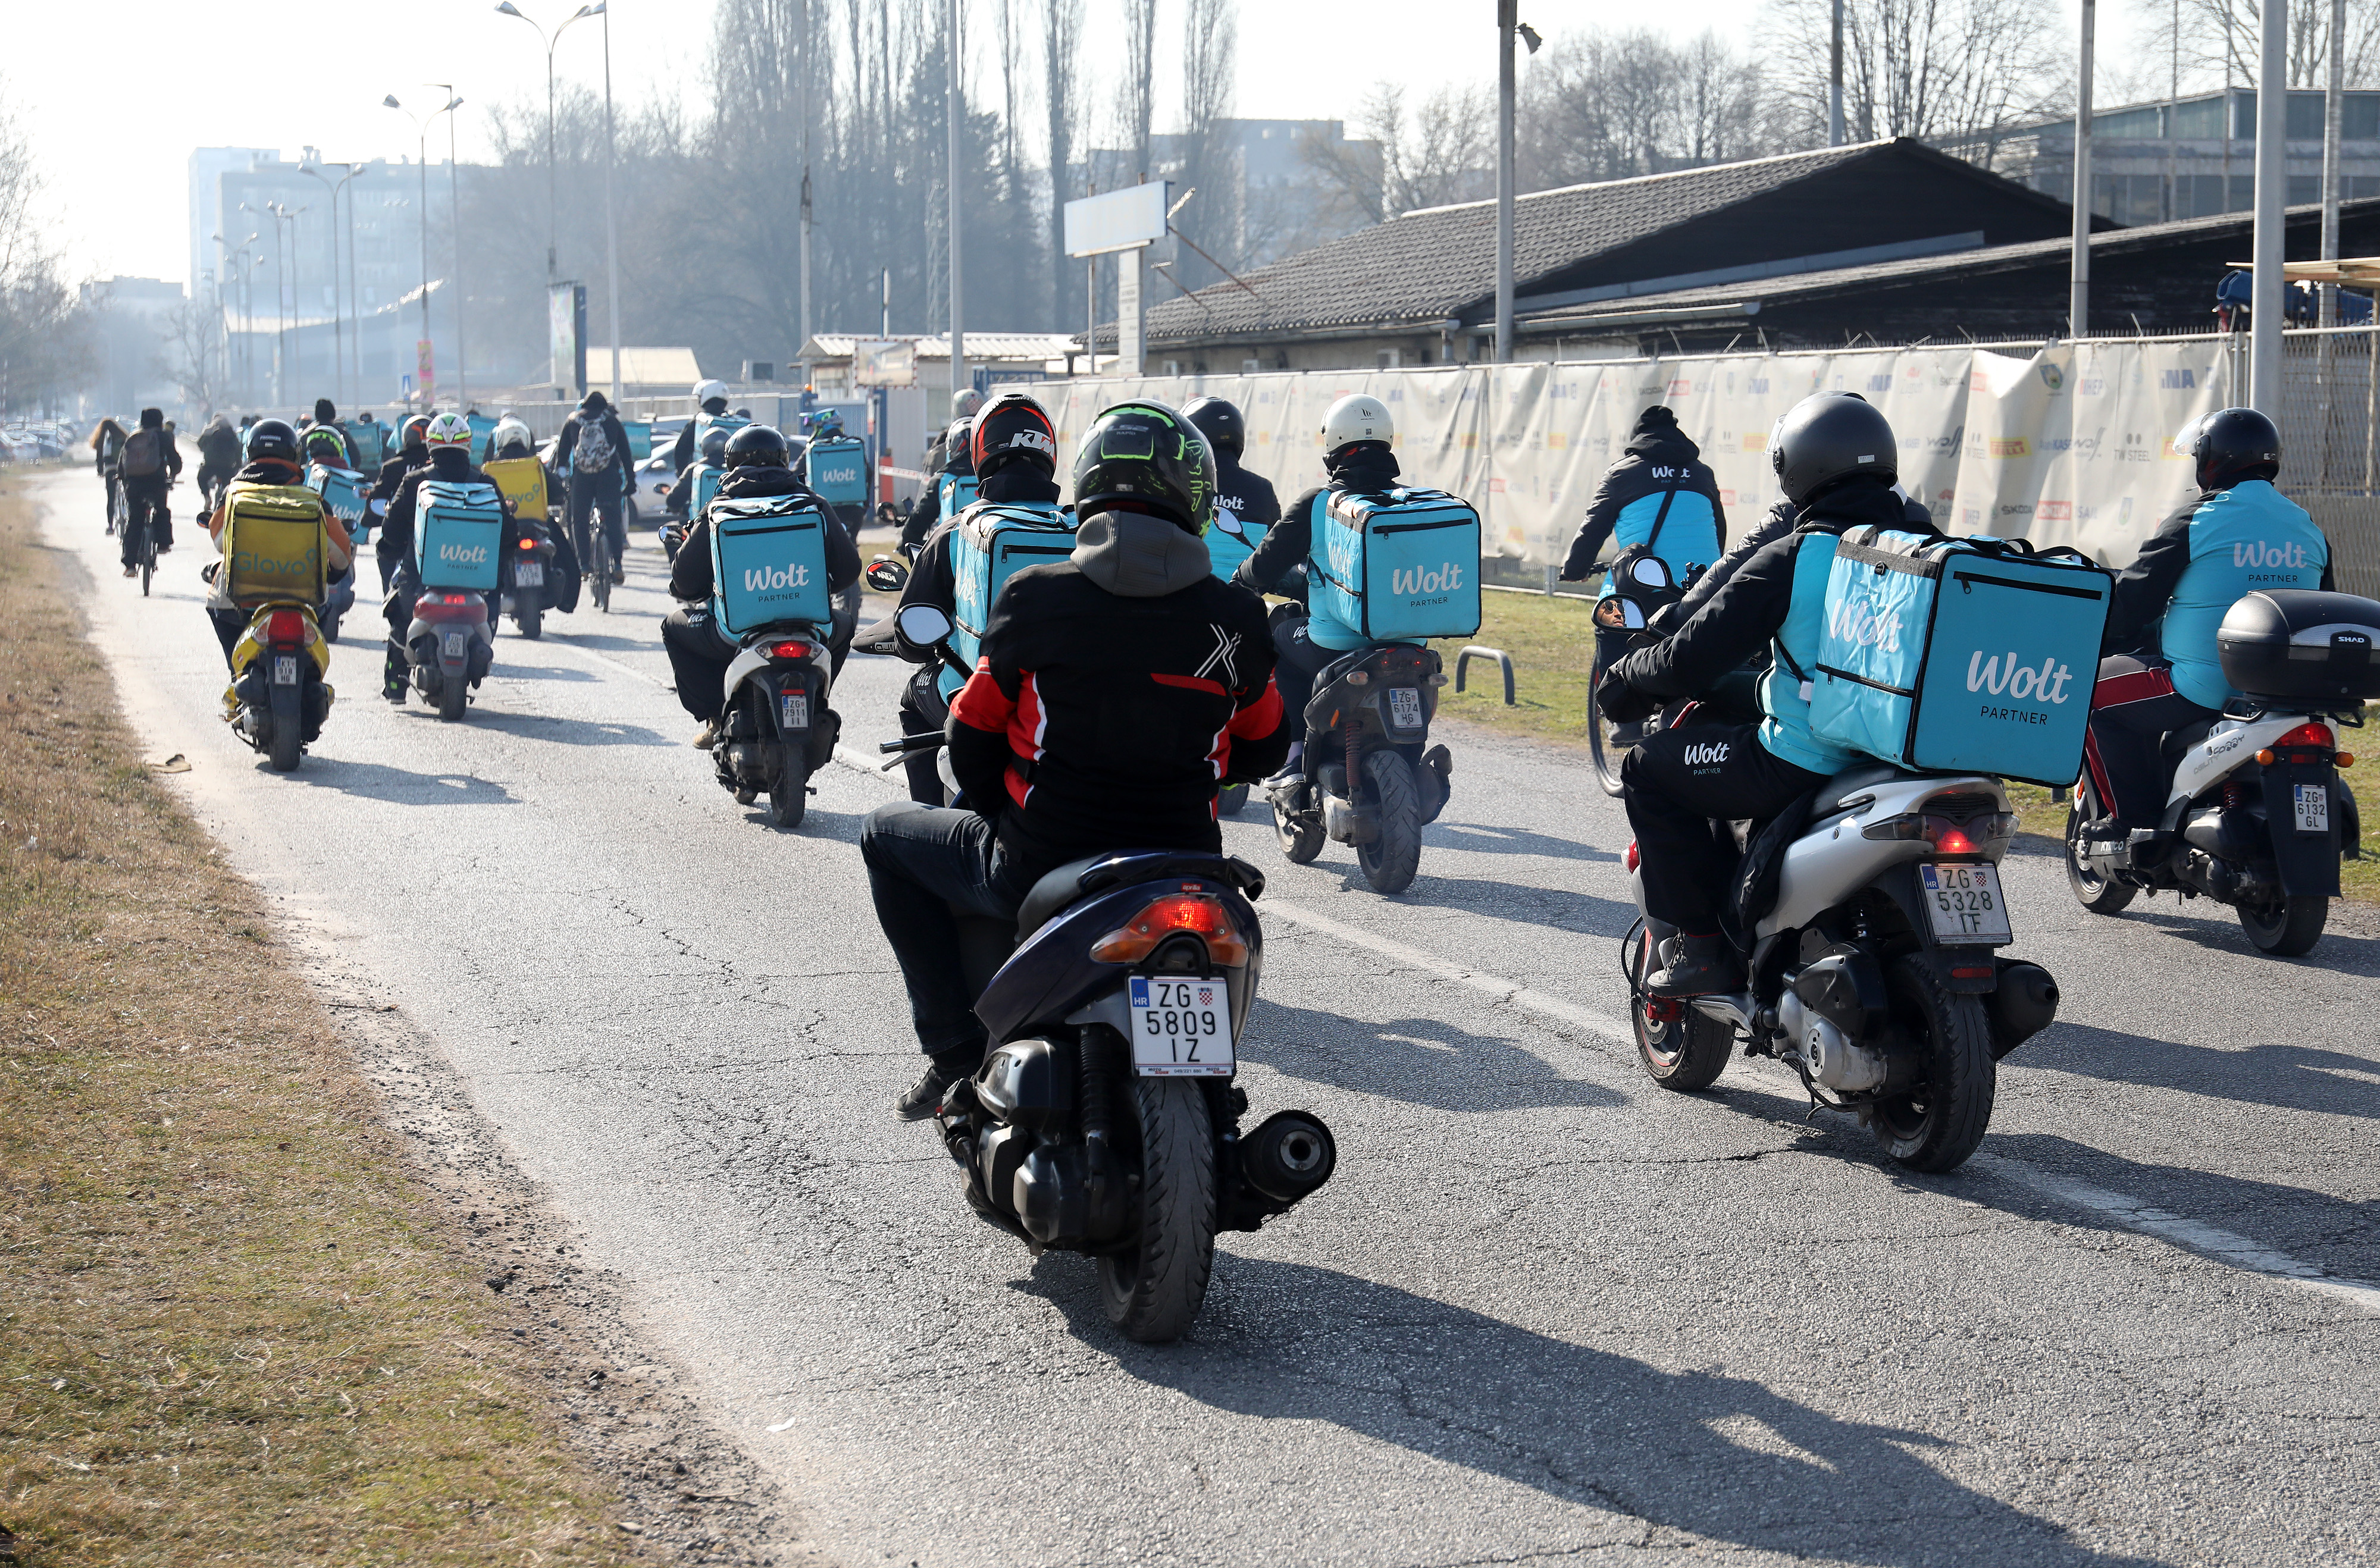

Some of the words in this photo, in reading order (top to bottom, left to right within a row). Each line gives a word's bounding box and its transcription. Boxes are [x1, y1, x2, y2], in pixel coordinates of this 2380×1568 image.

[1009, 429, 1055, 458] KTM
[822, 468, 856, 483] Wolt
[1652, 466, 1691, 479] Wot
[506, 493, 535, 503] ovo
[1212, 494, 1245, 510] Wolt
[440, 544, 488, 563] Wolt
[2234, 540, 2307, 569] Wolt
[234, 551, 307, 576] Glovo
[745, 563, 809, 592] Wolt
[1392, 562, 1463, 595] Wolt
[2248, 574, 2298, 583] PARTNER
[758, 593, 800, 603] PARTNER
[1410, 597, 1448, 607] PARTNER
[1829, 598, 1904, 653] Wolt
[1966, 650, 2073, 704] Wolt
[790, 700, 800, 708] ZG
[1399, 693, 1411, 703] ZG
[785, 708, 805, 717] 7911
[1393, 703, 1418, 713] 6174
[1980, 705, 2048, 726] PARTNER
[1402, 713, 1414, 723] HG
[1684, 741, 1730, 766] Wolt
[1693, 767, 1722, 776] PARTNER
[2304, 791, 2318, 802] ZG
[2297, 803, 2325, 816] 6132
[2306, 816, 2319, 827] GL
[1943, 869, 1970, 889] ZG
[1937, 890, 1993, 912] 5328
[1134, 997, 1148, 1005] HR
[1157, 983, 1191, 1008] ZG
[1146, 1011, 1216, 1036] 5809
[1171, 1038, 1201, 1062] IZ
